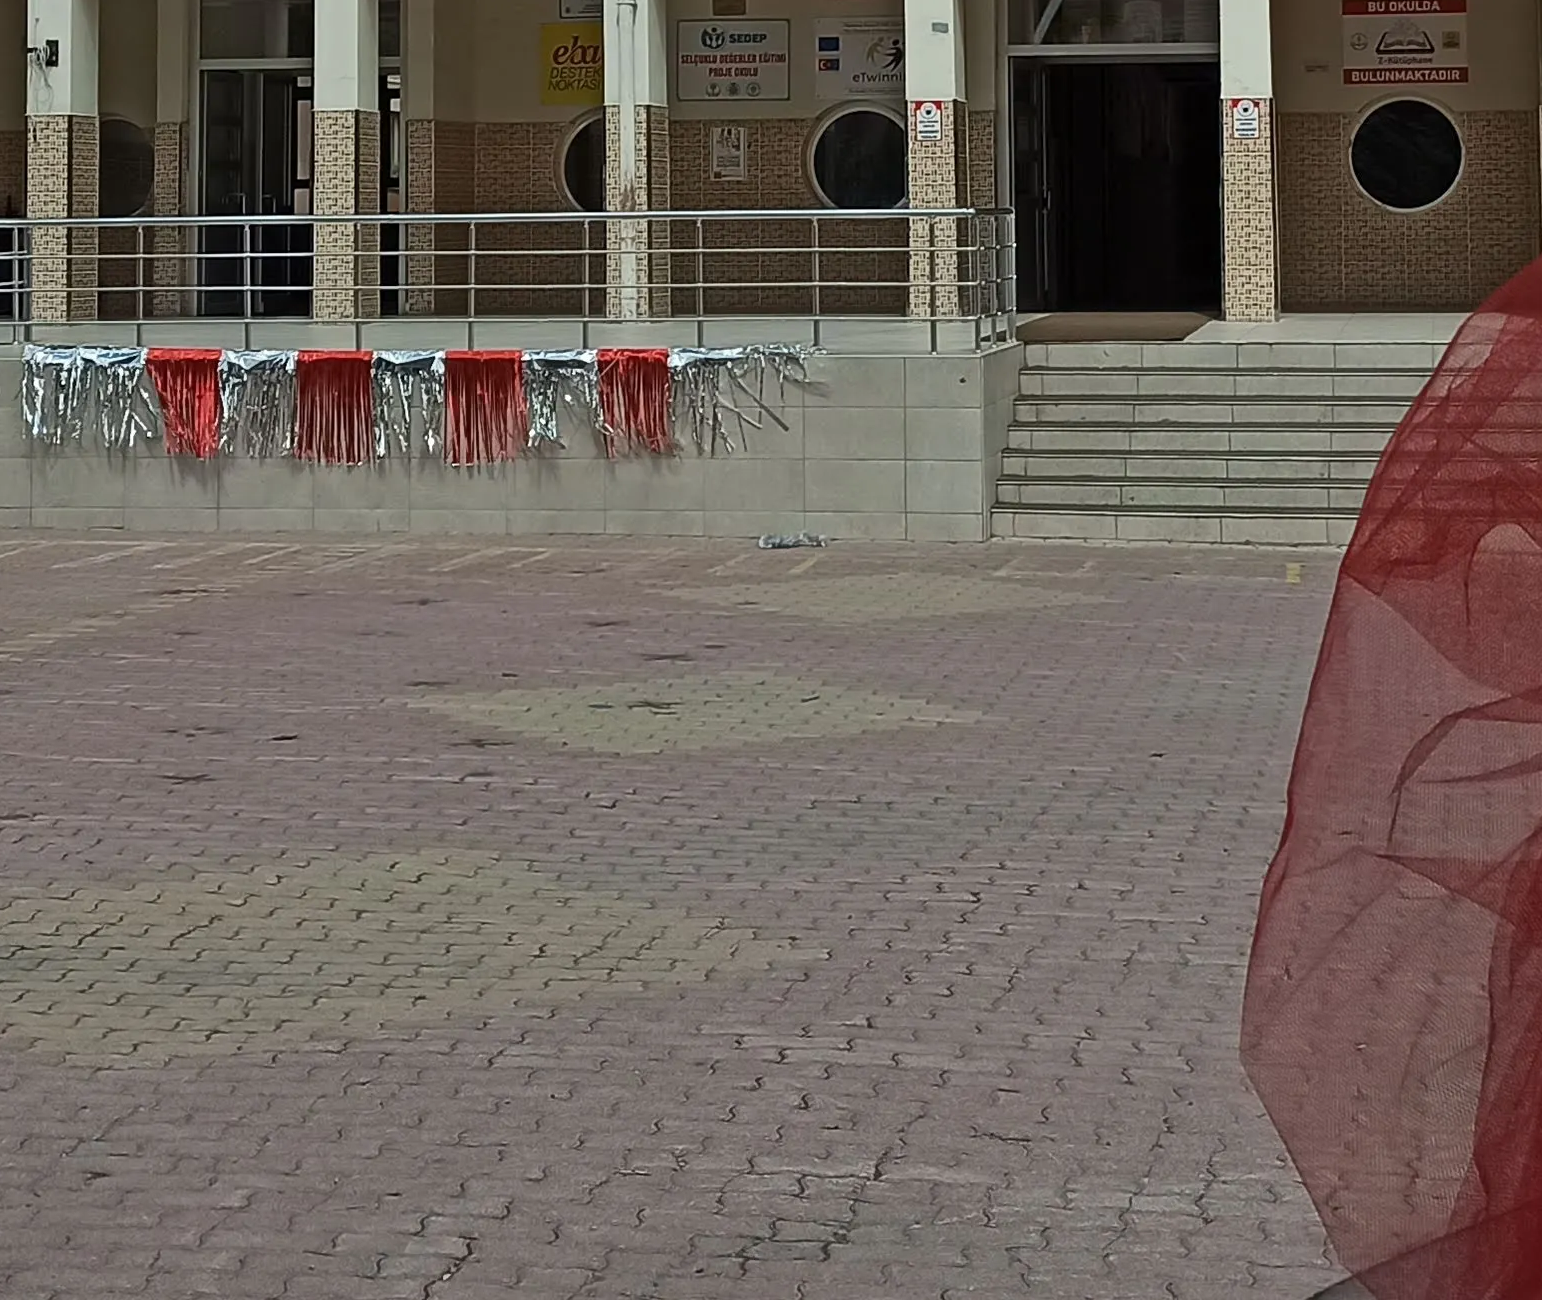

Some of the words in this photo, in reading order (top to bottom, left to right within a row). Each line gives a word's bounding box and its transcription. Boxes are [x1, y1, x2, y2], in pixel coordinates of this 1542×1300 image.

[1367, 1, 1385, 12] BU
[1389, 0, 1441, 12] OKULDA
[728, 33, 767, 44] SEDEP
[552, 35, 601, 65] eba
[550, 66, 602, 79] DESTEK
[1351, 69, 1460, 82] BULUNMAKTADIR
